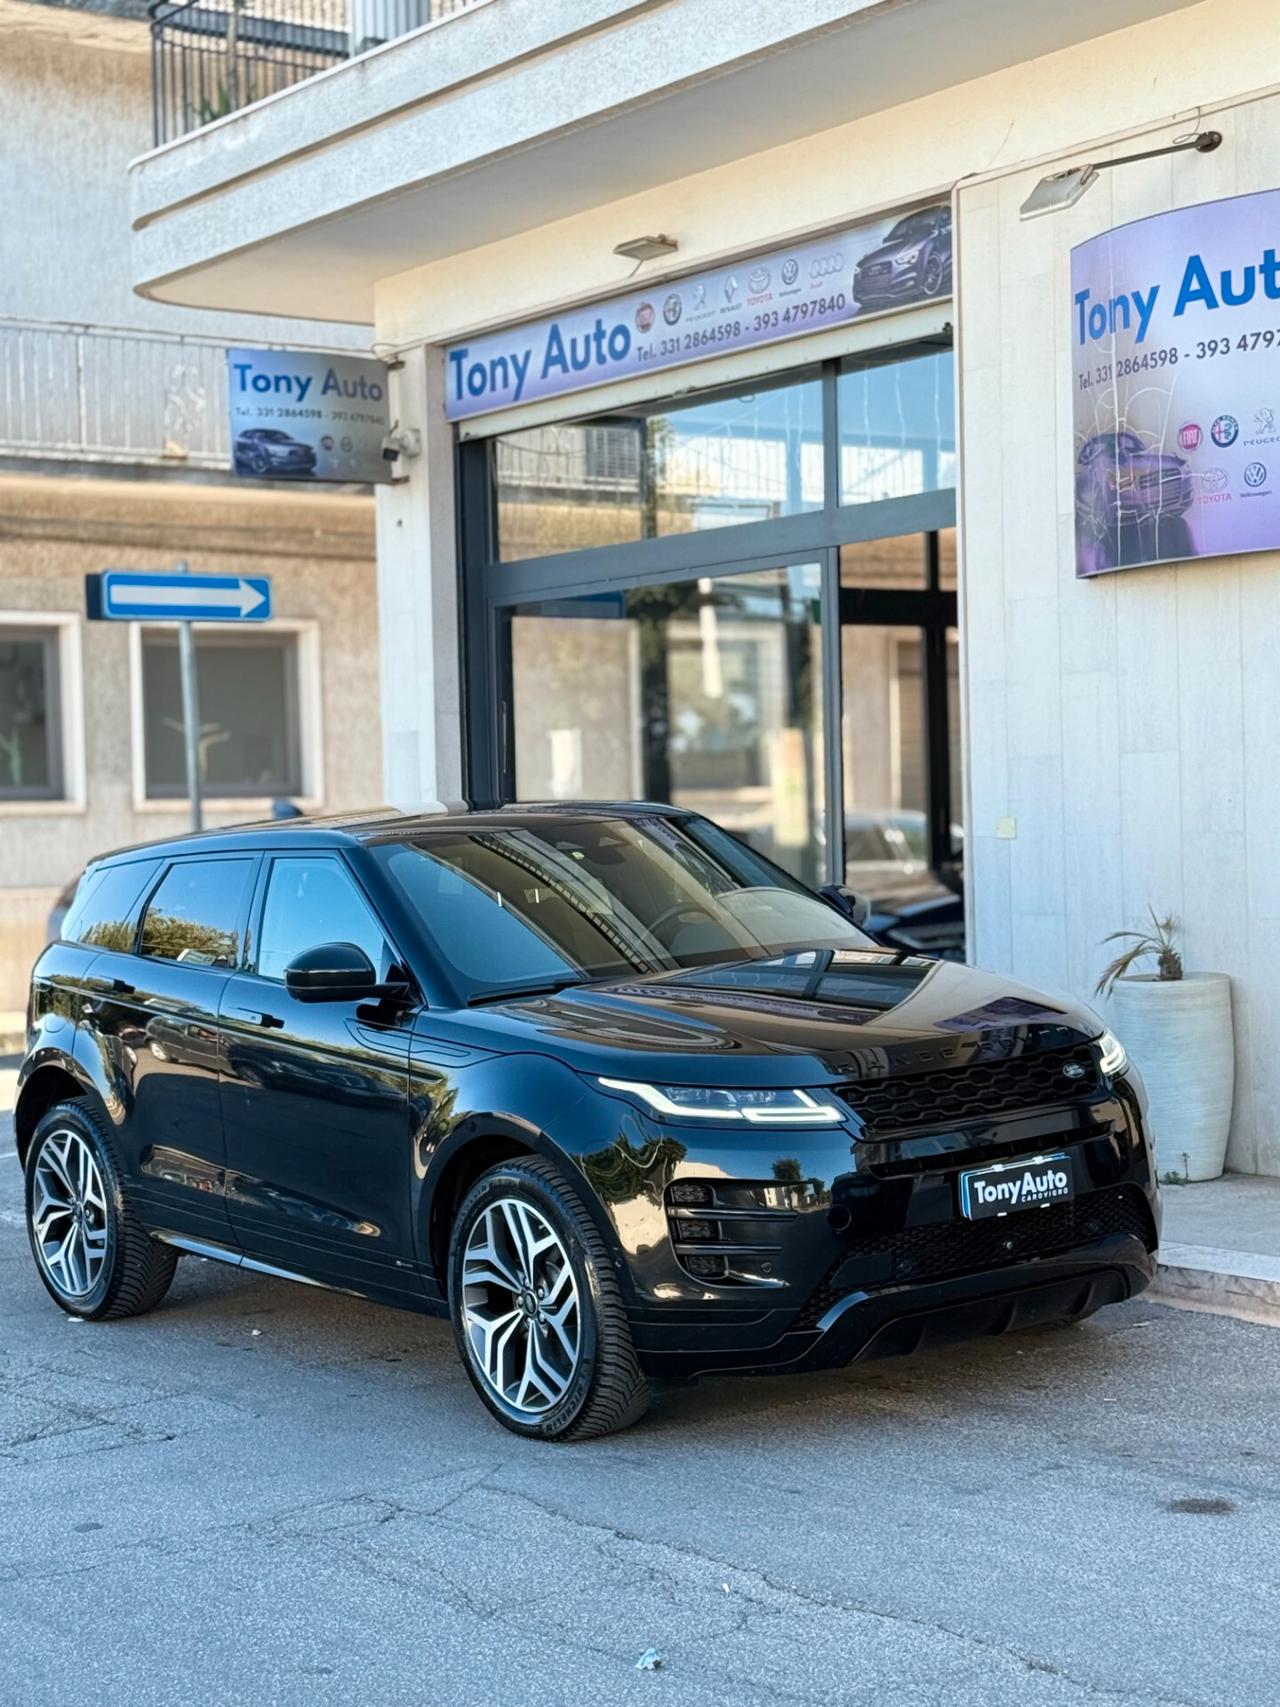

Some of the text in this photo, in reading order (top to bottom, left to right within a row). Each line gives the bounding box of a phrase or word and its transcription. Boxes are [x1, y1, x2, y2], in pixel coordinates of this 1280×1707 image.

[636, 345, 657, 362] Tel.
[660, 339, 681, 356] 331
[684, 321, 741, 350] 2864598
[754, 311, 779, 332] 393
[782, 293, 846, 323] 4797840
[1075, 284, 1161, 345] Tony
[450, 319, 631, 401] Tony Auto
[1078, 374, 1094, 390] Tel.
[1096, 365, 1112, 384] 331
[1116, 347, 1179, 378] 2864598
[1196, 337, 1230, 359] 393
[233, 364, 383, 402] Tony Auto
[257, 408, 274, 417] 331
[1197, 493, 1232, 504] TOYOTA
[1021, 1187, 1068, 1202] CAROVIGNO
